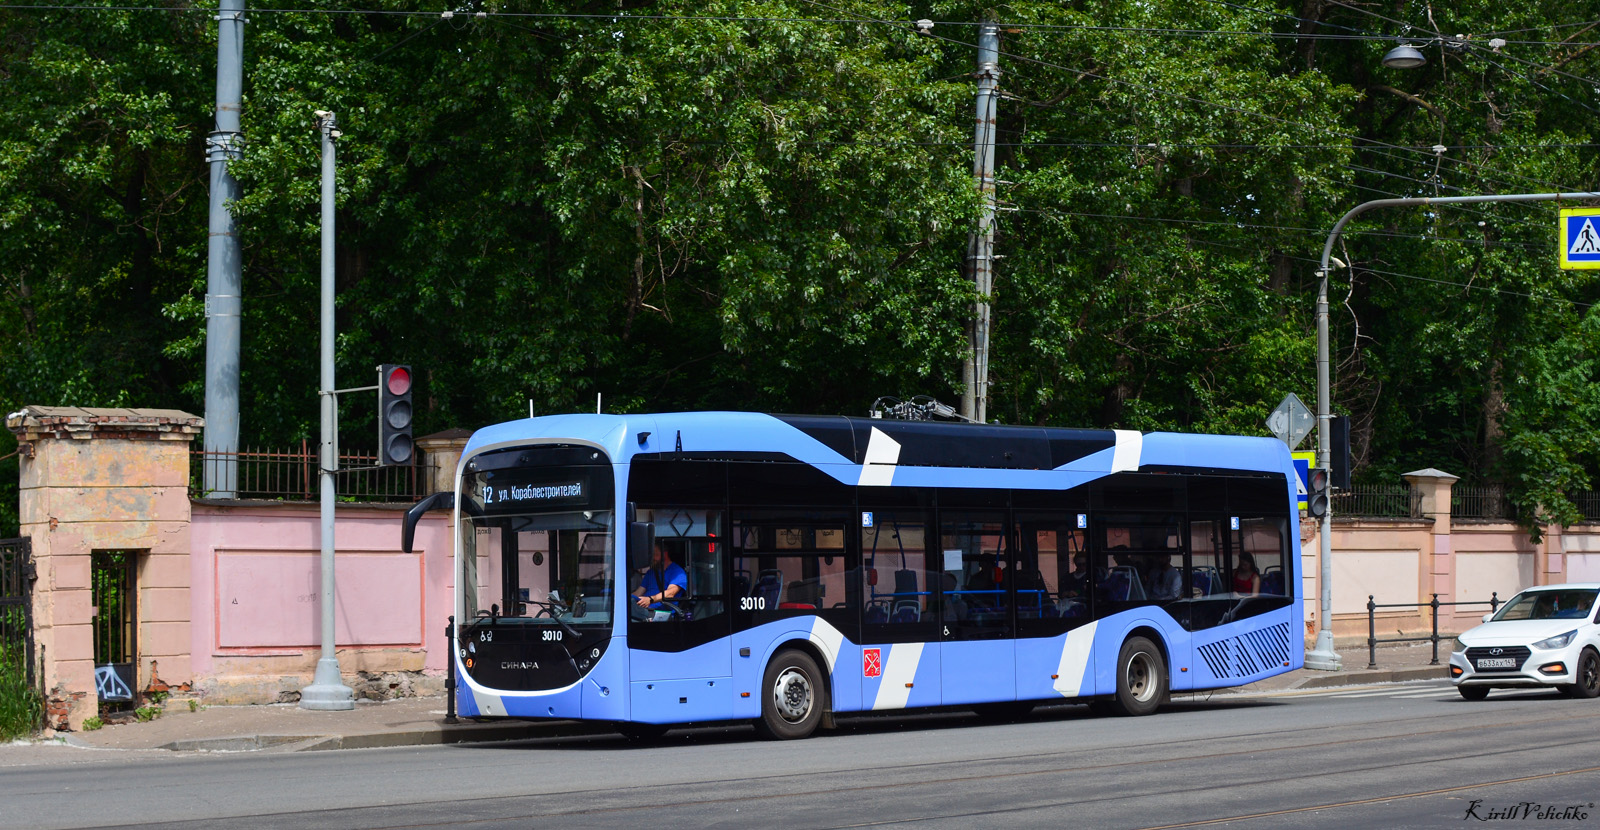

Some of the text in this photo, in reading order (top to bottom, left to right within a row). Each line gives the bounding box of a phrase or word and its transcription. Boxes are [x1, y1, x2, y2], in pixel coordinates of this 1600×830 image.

[482, 482, 581, 503] 12 ул. Кораблестроителей
[740, 596, 765, 610] 3010
[541, 630, 563, 641] 3010
[501, 661, 539, 670] СИНАРА
